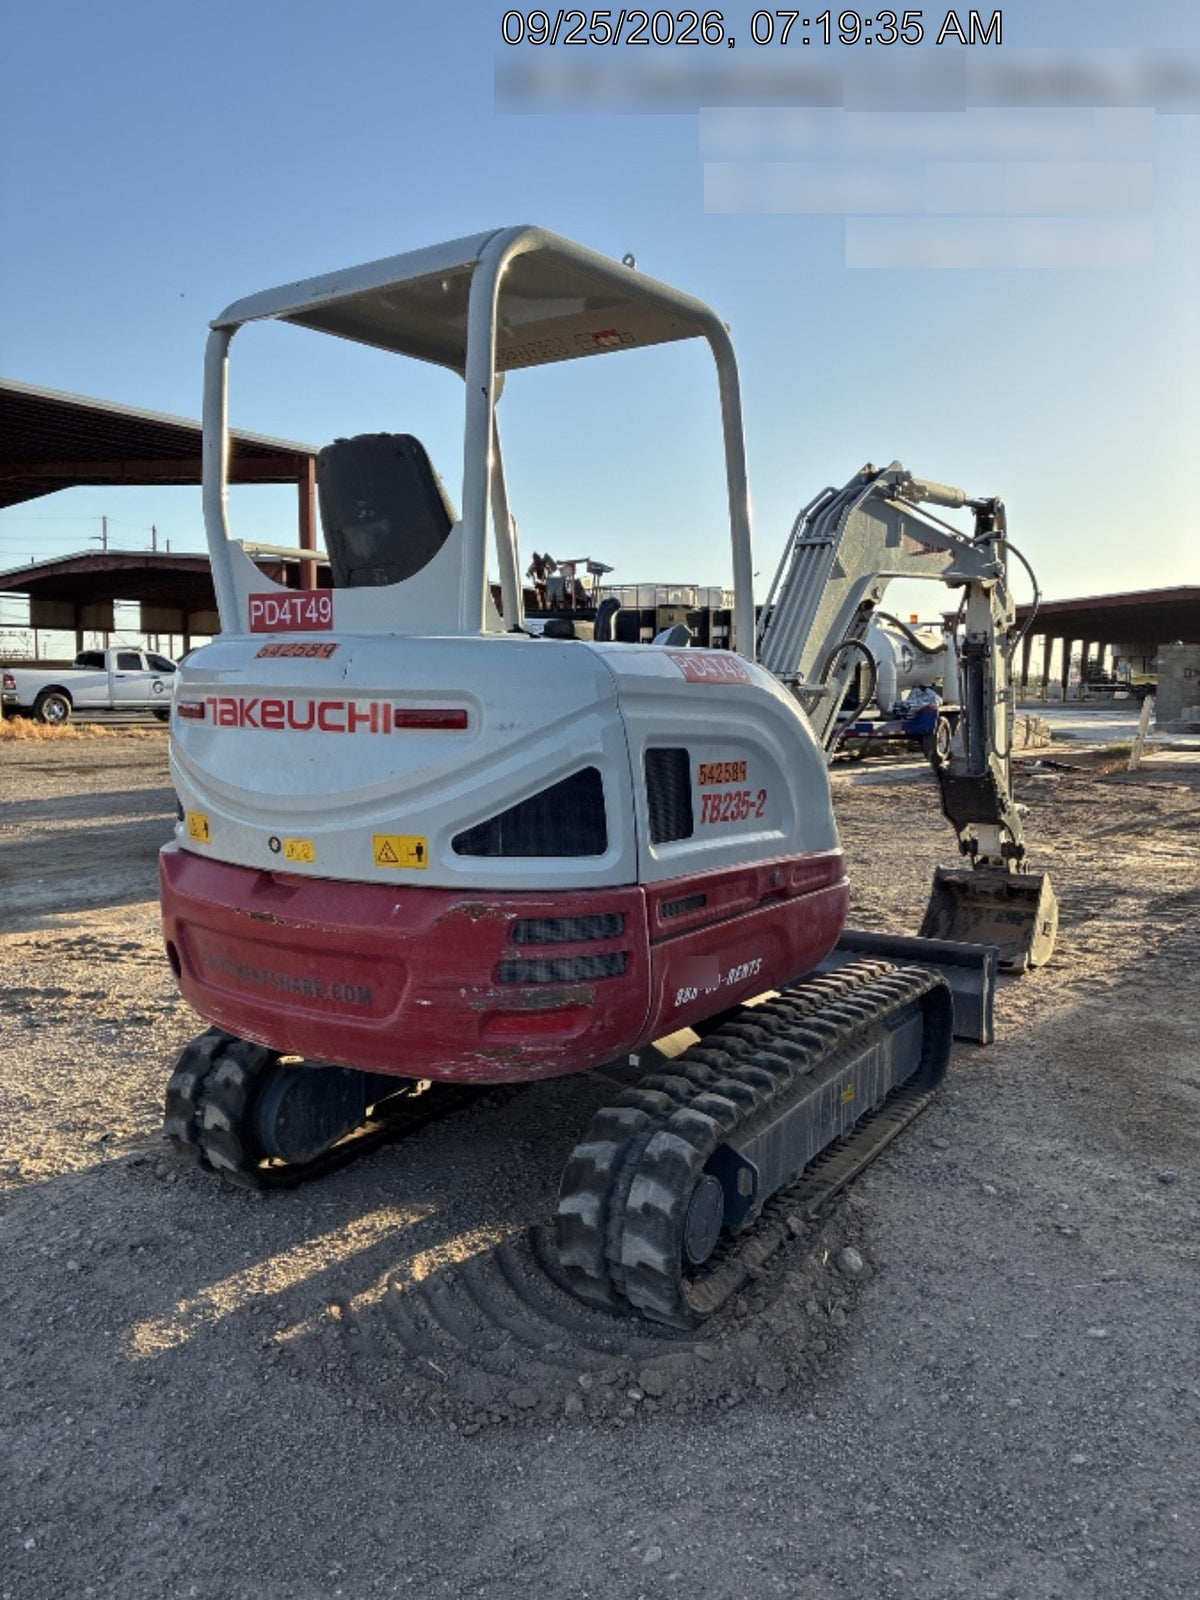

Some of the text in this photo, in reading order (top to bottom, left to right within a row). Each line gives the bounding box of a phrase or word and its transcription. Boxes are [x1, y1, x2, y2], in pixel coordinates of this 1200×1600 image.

[251, 596, 332, 626] PD4T49
[699, 760, 747, 786] 542589
[701, 788, 767, 825] TB235-2
